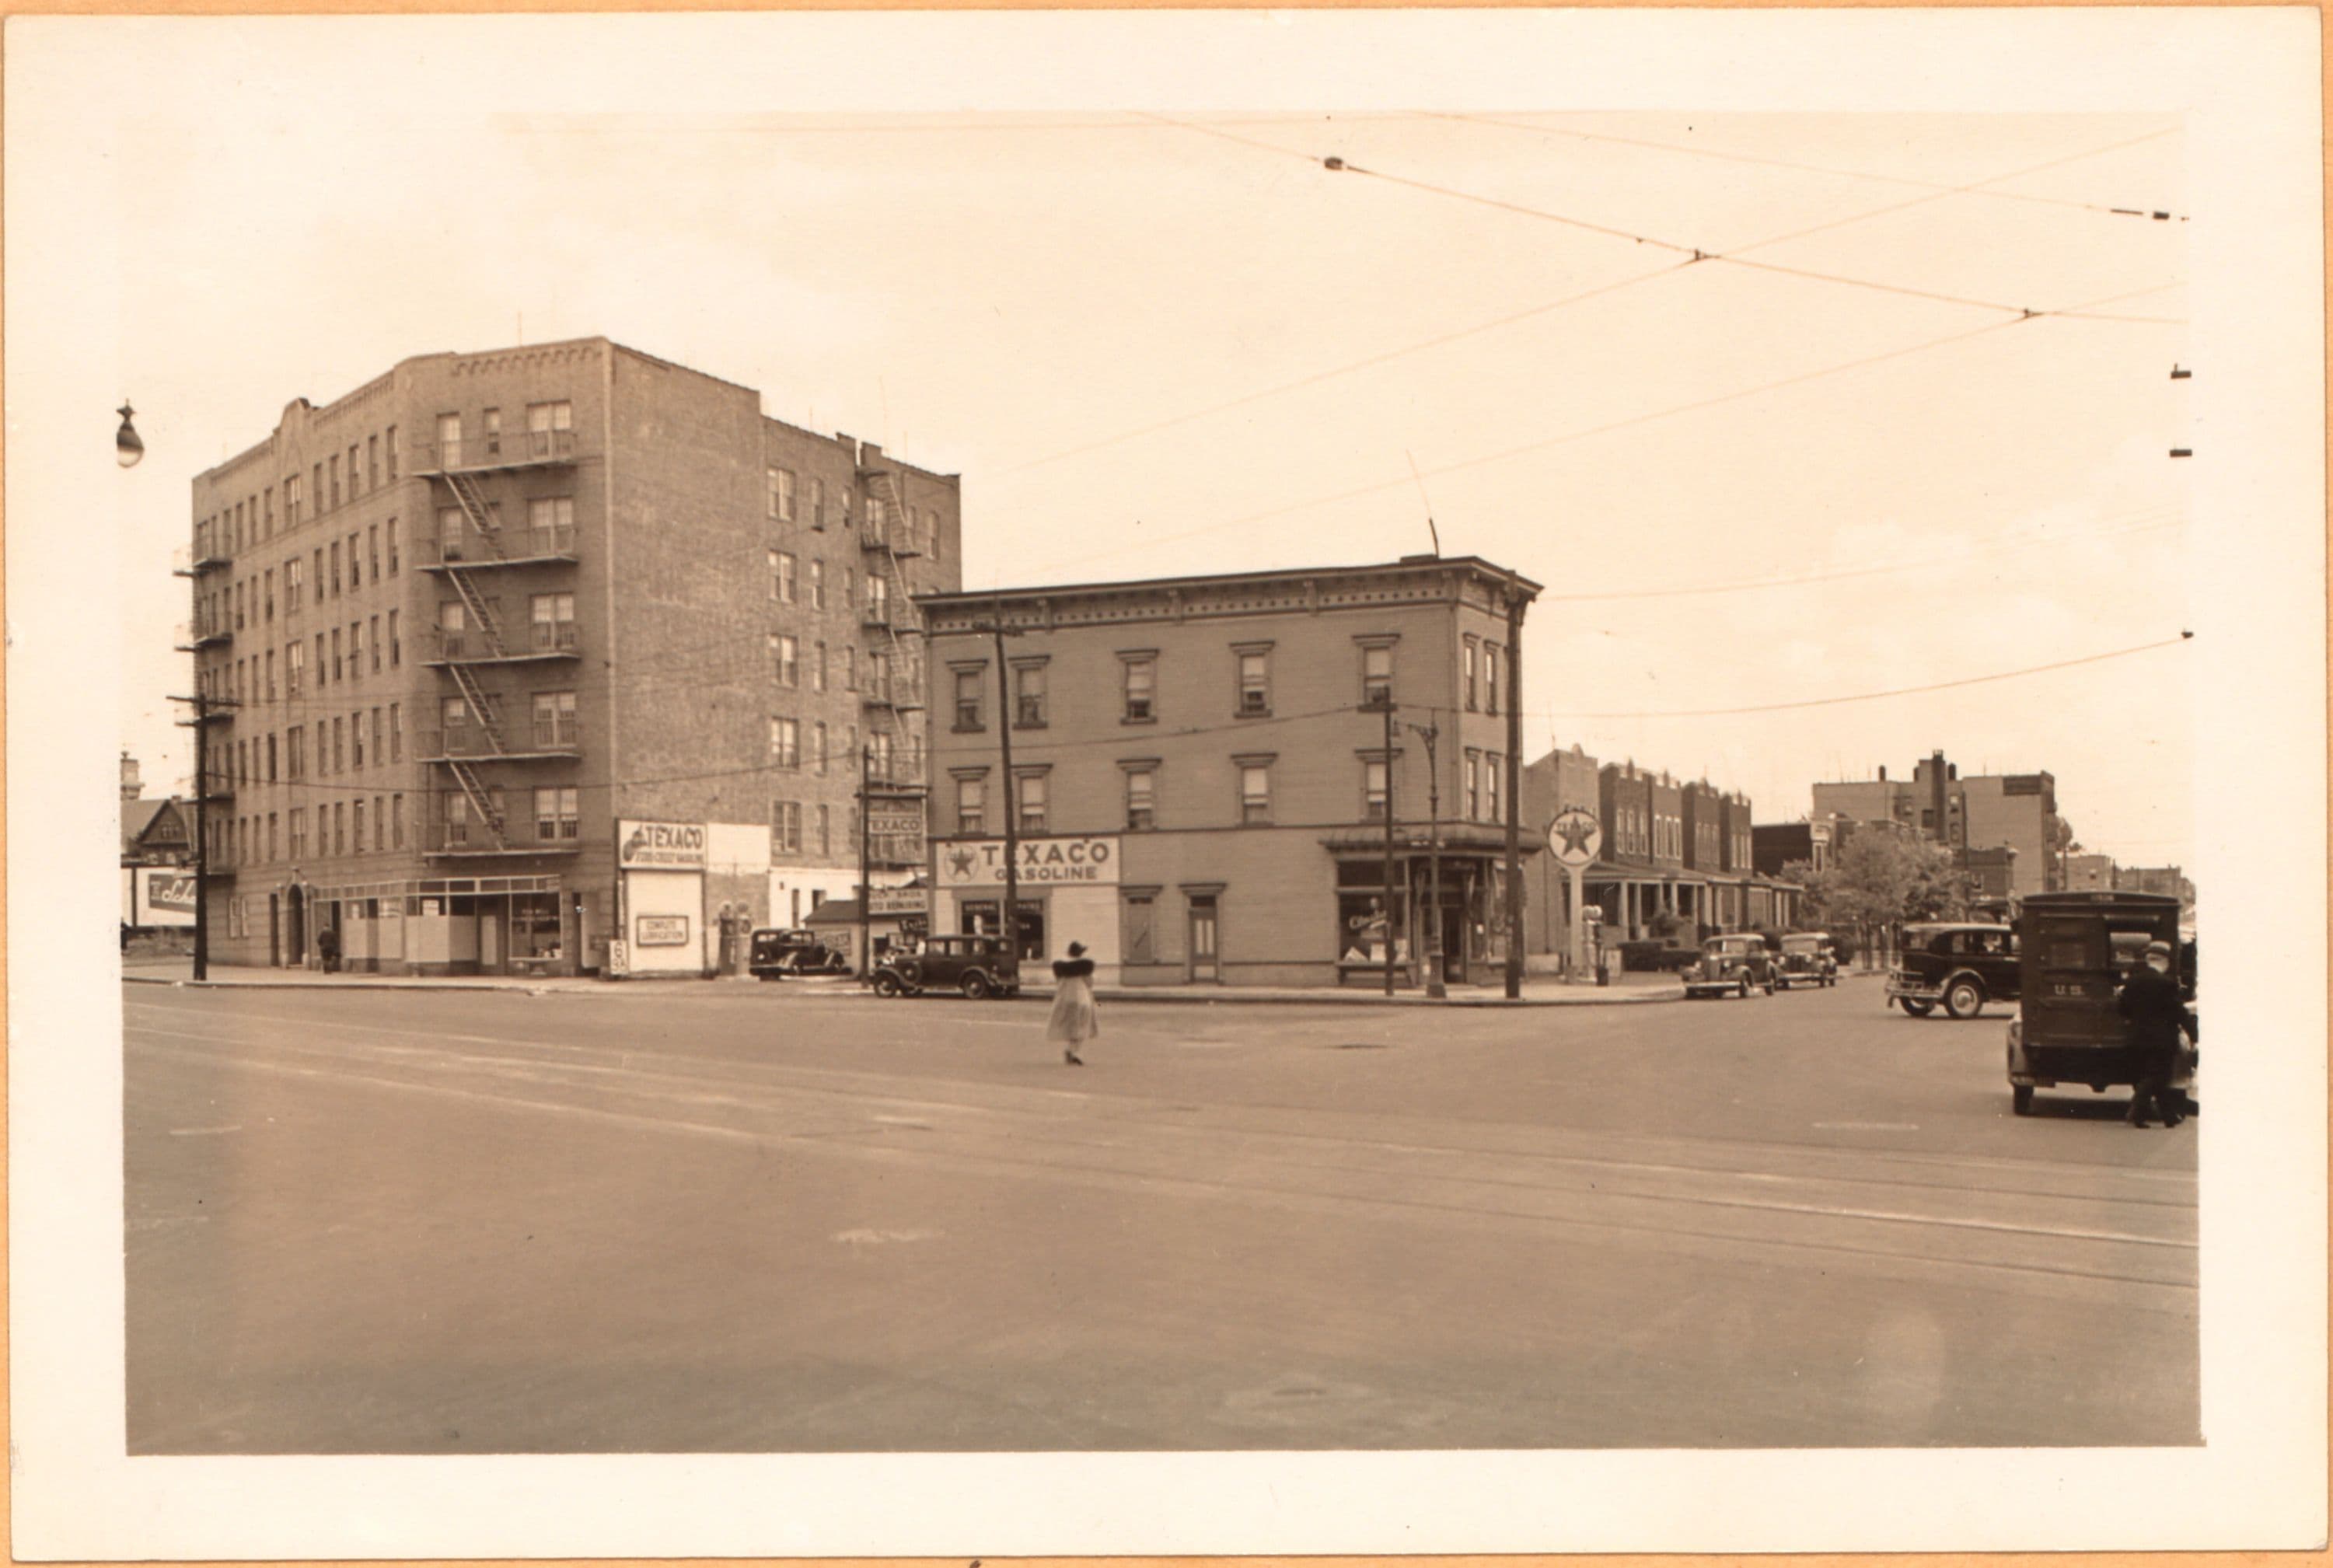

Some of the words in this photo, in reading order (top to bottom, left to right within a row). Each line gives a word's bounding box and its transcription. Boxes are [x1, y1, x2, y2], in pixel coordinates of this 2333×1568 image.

[869, 819, 920, 831] EXACO
[645, 825, 703, 850] TEXACO
[868, 902, 884, 910] UTO
